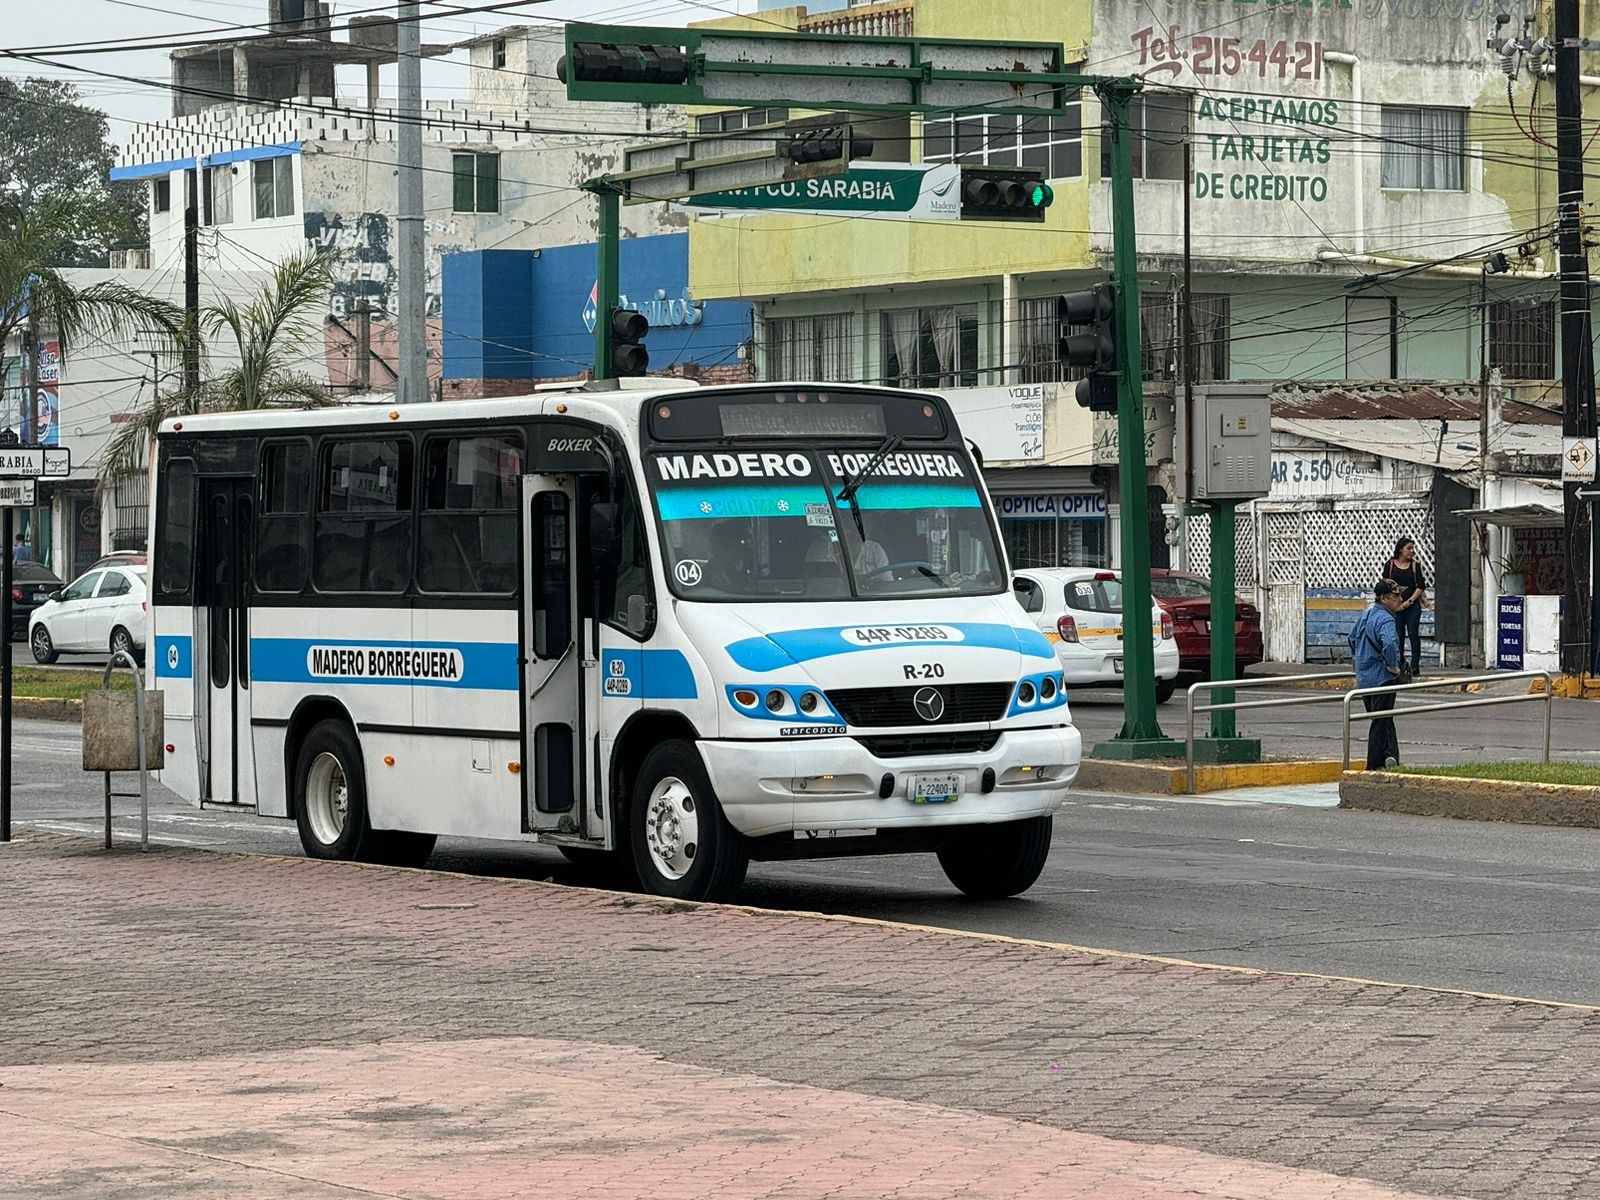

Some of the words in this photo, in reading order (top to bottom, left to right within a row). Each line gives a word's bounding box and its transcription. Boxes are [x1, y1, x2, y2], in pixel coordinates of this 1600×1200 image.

[1131, 25, 1188, 67] Tel.
[1198, 97, 1338, 125] ACEPTAMOS
[1207, 134, 1331, 164] TARJETAS
[806, 178, 895, 200] SARABIA
[1196, 172, 1224, 198] DE
[1230, 173, 1328, 202] CREDITO
[930, 201, 957, 209] Madero
[547, 438, 593, 452] BOXER
[655, 453, 812, 481] MADERO
[1293, 459, 1332, 483] 3.50
[1002, 496, 1056, 514] OPTICA
[678, 564, 698, 580] 04
[1077, 586, 1092, 595] 030
[1501, 605, 1522, 614] RICAS
[855, 626, 948, 643] 44P-0289
[1500, 622, 1521, 630] TORTAS
[313, 649, 365, 675] MADERO
[368, 650, 457, 678] BORREGUERA
[1501, 654, 1521, 662] BARDA
[611, 661, 624, 674] R-20
[903, 663, 945, 680] R-20
[782, 726, 846, 735] Marcopolo
